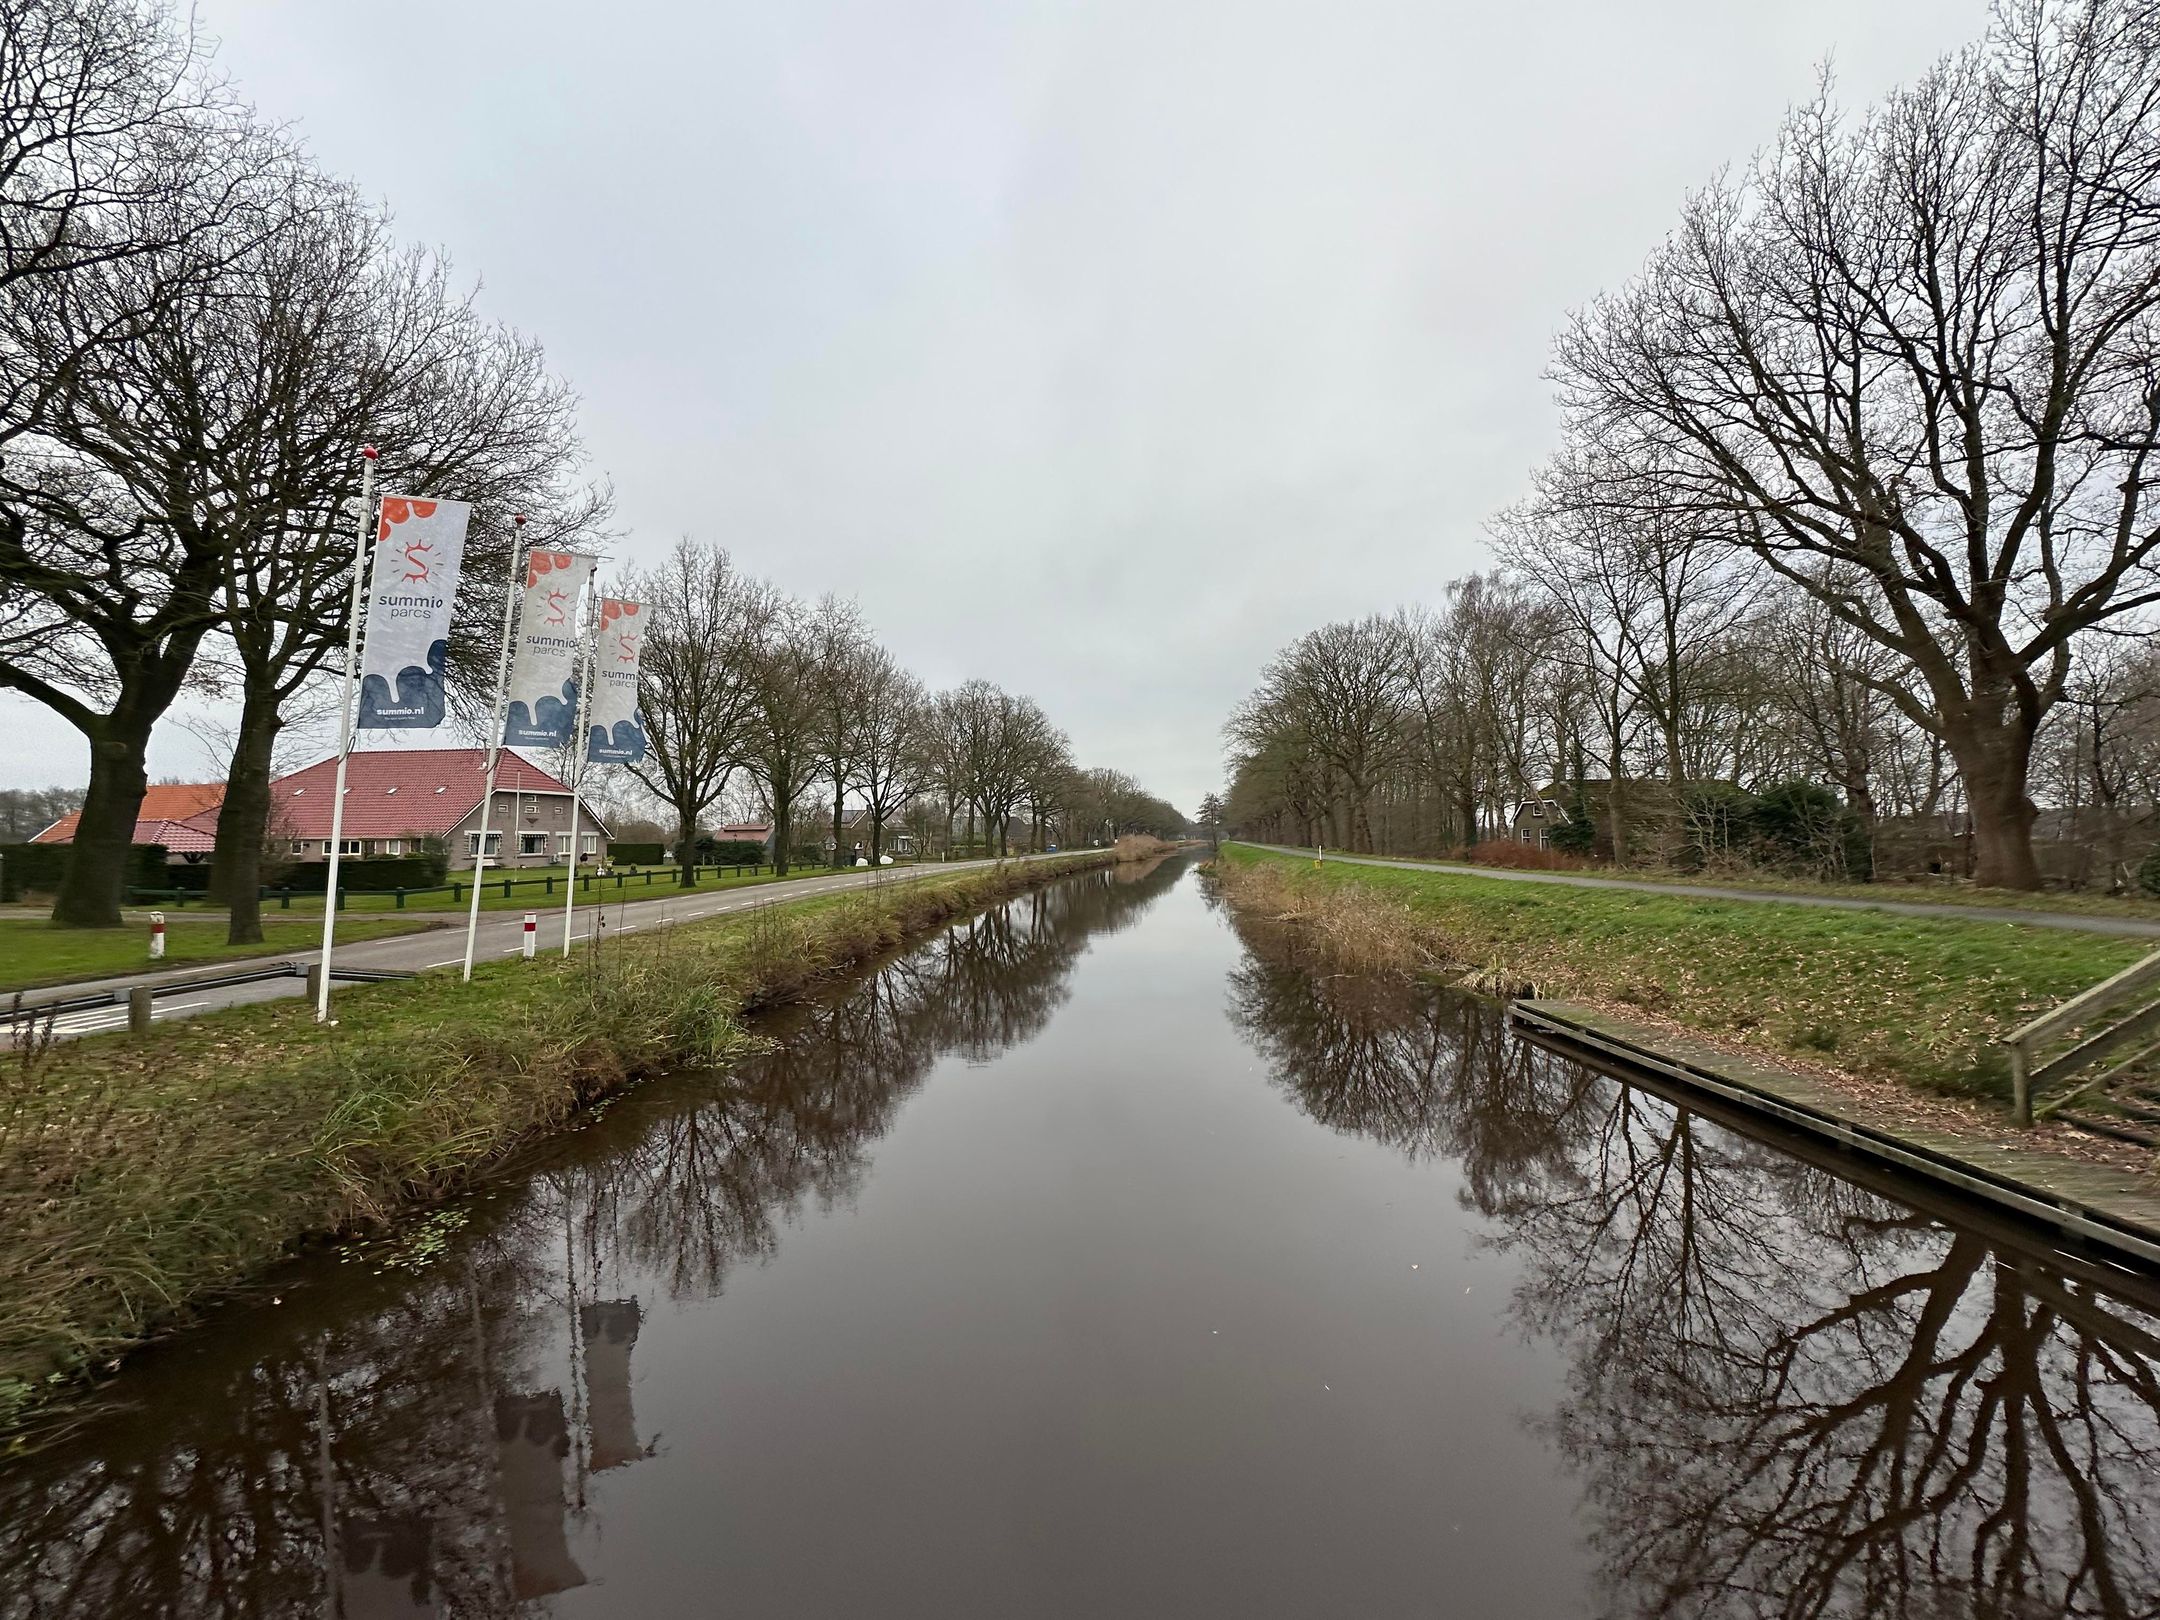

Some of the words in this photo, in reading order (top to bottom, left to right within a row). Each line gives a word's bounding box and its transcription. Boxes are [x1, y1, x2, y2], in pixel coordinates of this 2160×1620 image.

[378, 595, 443, 609] summio
[390, 608, 432, 620] parcs
[526, 635, 576, 649] summio
[533, 646, 566, 658] parcs
[609, 679, 637, 689] parcs
[376, 706, 425, 716] summio.nl
[518, 729, 557, 738] summio.nl
[598, 748, 633, 756] summio.nl
